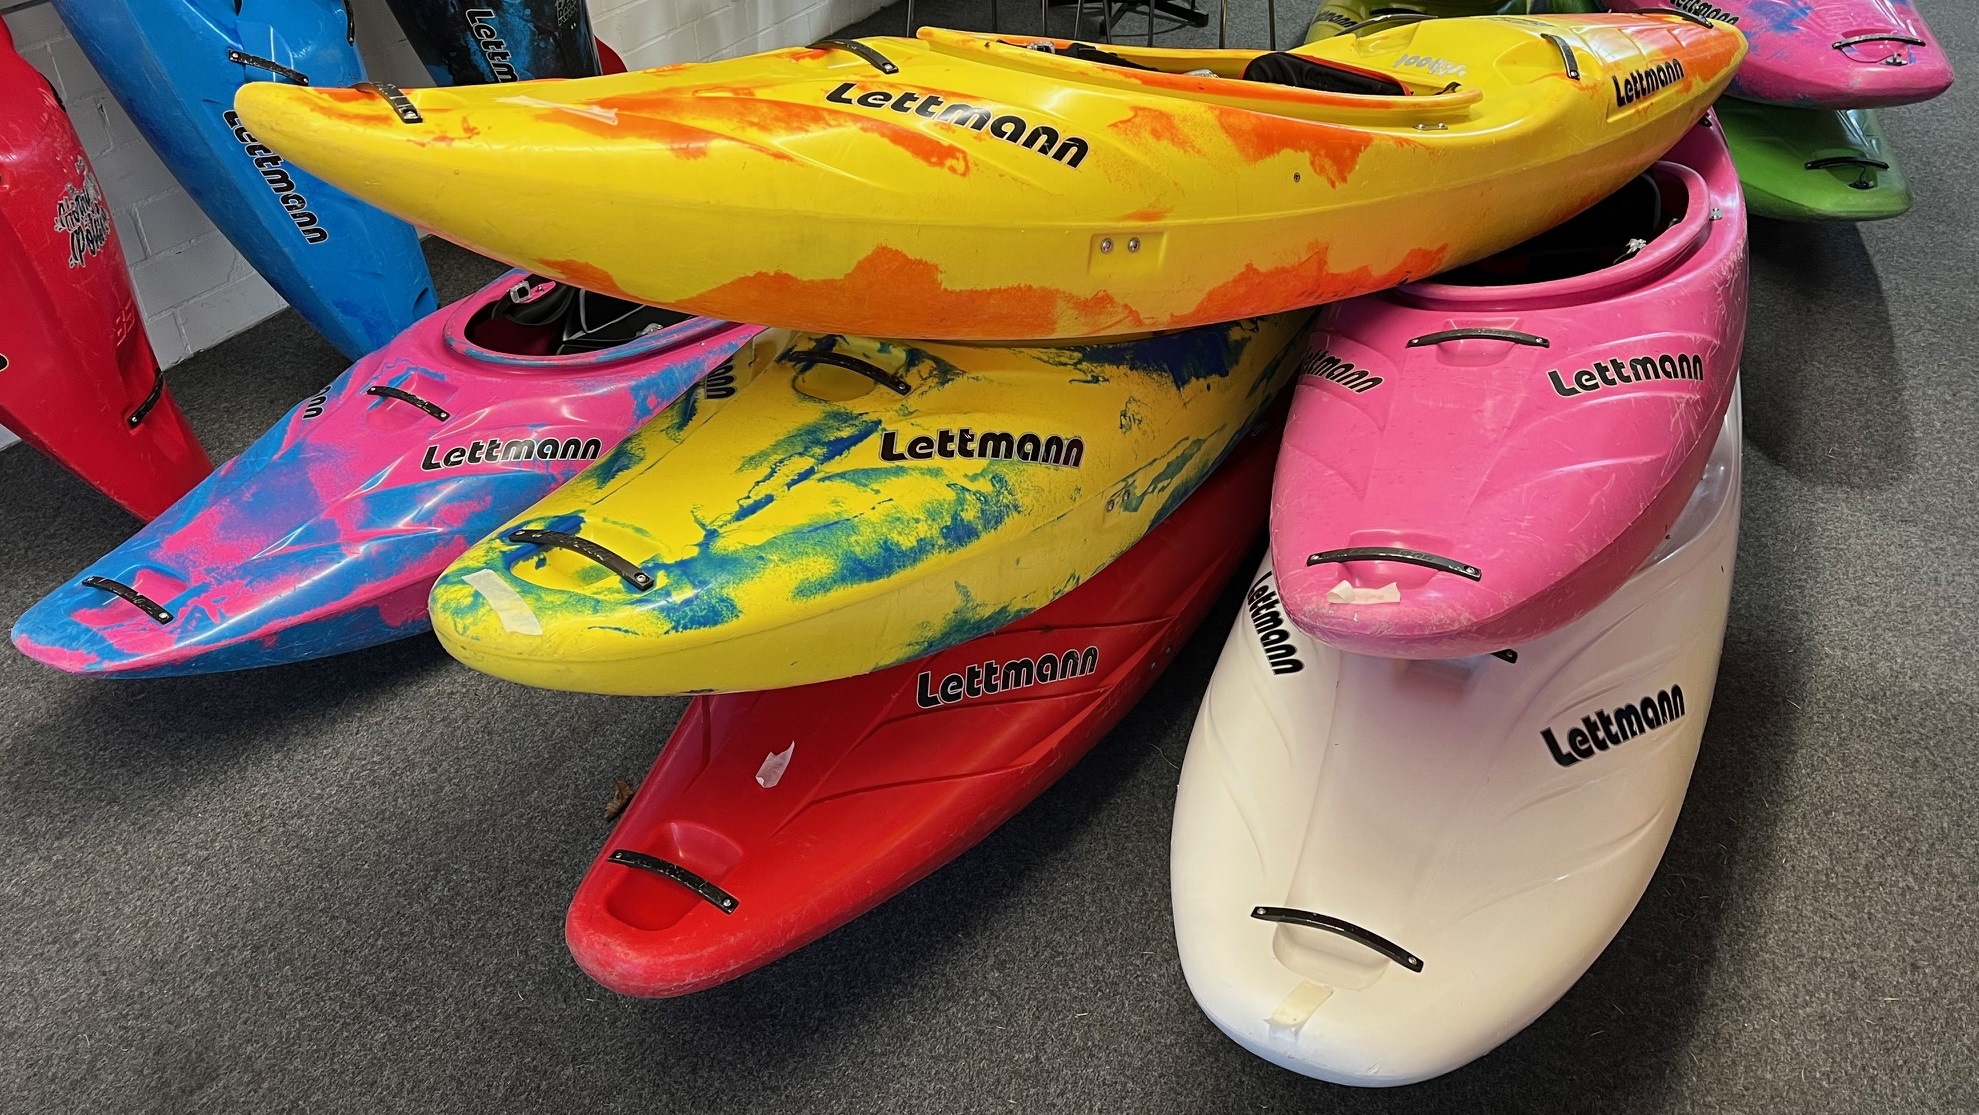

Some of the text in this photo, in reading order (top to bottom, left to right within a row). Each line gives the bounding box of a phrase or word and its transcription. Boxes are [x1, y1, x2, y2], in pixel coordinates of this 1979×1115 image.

[466, 9, 519, 83] Lettm
[1612, 57, 1685, 108] Lettmann
[825, 82, 1090, 169] Lettmann
[223, 110, 326, 244] Lettmann
[1546, 353, 1704, 397] Lettmann
[420, 437, 602, 471] Lettmann
[878, 428, 1085, 468] Lettmann
[1247, 570, 1305, 676] Lettmann
[917, 645, 1099, 708] Lettmann
[1540, 683, 1686, 768] Lettmann
